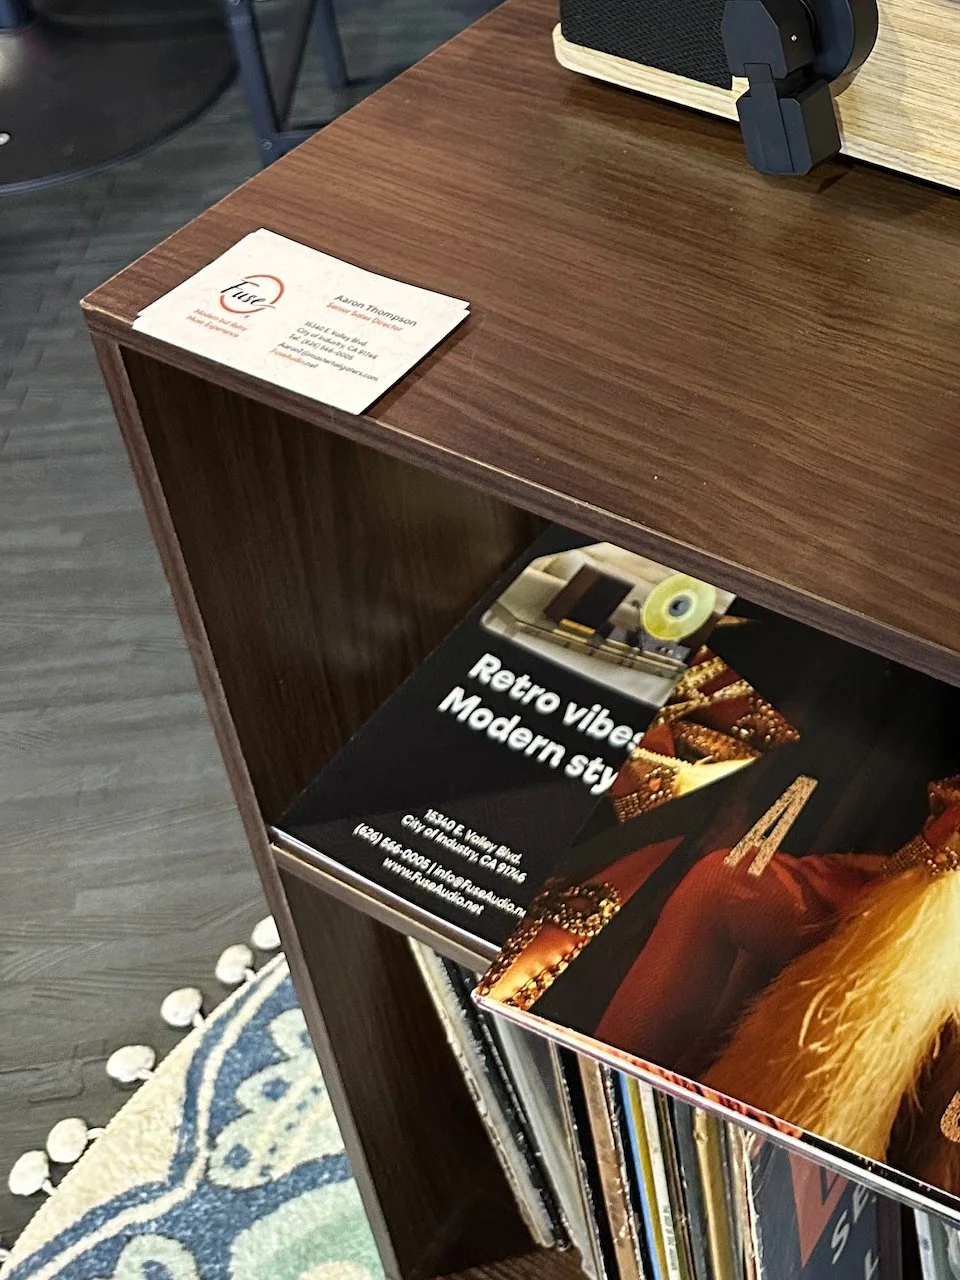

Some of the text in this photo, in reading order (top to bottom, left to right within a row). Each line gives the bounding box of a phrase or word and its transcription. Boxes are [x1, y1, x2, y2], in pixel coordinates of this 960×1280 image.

[220, 279, 276, 309] Fuse
[334, 295, 418, 327] Aaron Thompson
[296, 327, 310, 337] City
[347, 345, 358, 353] CA
[468, 652, 561, 714] Retro
[437, 686, 566, 769] Modern
[352, 822, 384, 846] (626)
[401, 814, 527, 885] City of Industry, CA 91746
[424, 808, 456, 832] 15340
[464, 829, 498, 853] Valley
[723, 775, 818, 878] A
[382, 856, 485, 916] www.FuseAudio.net
